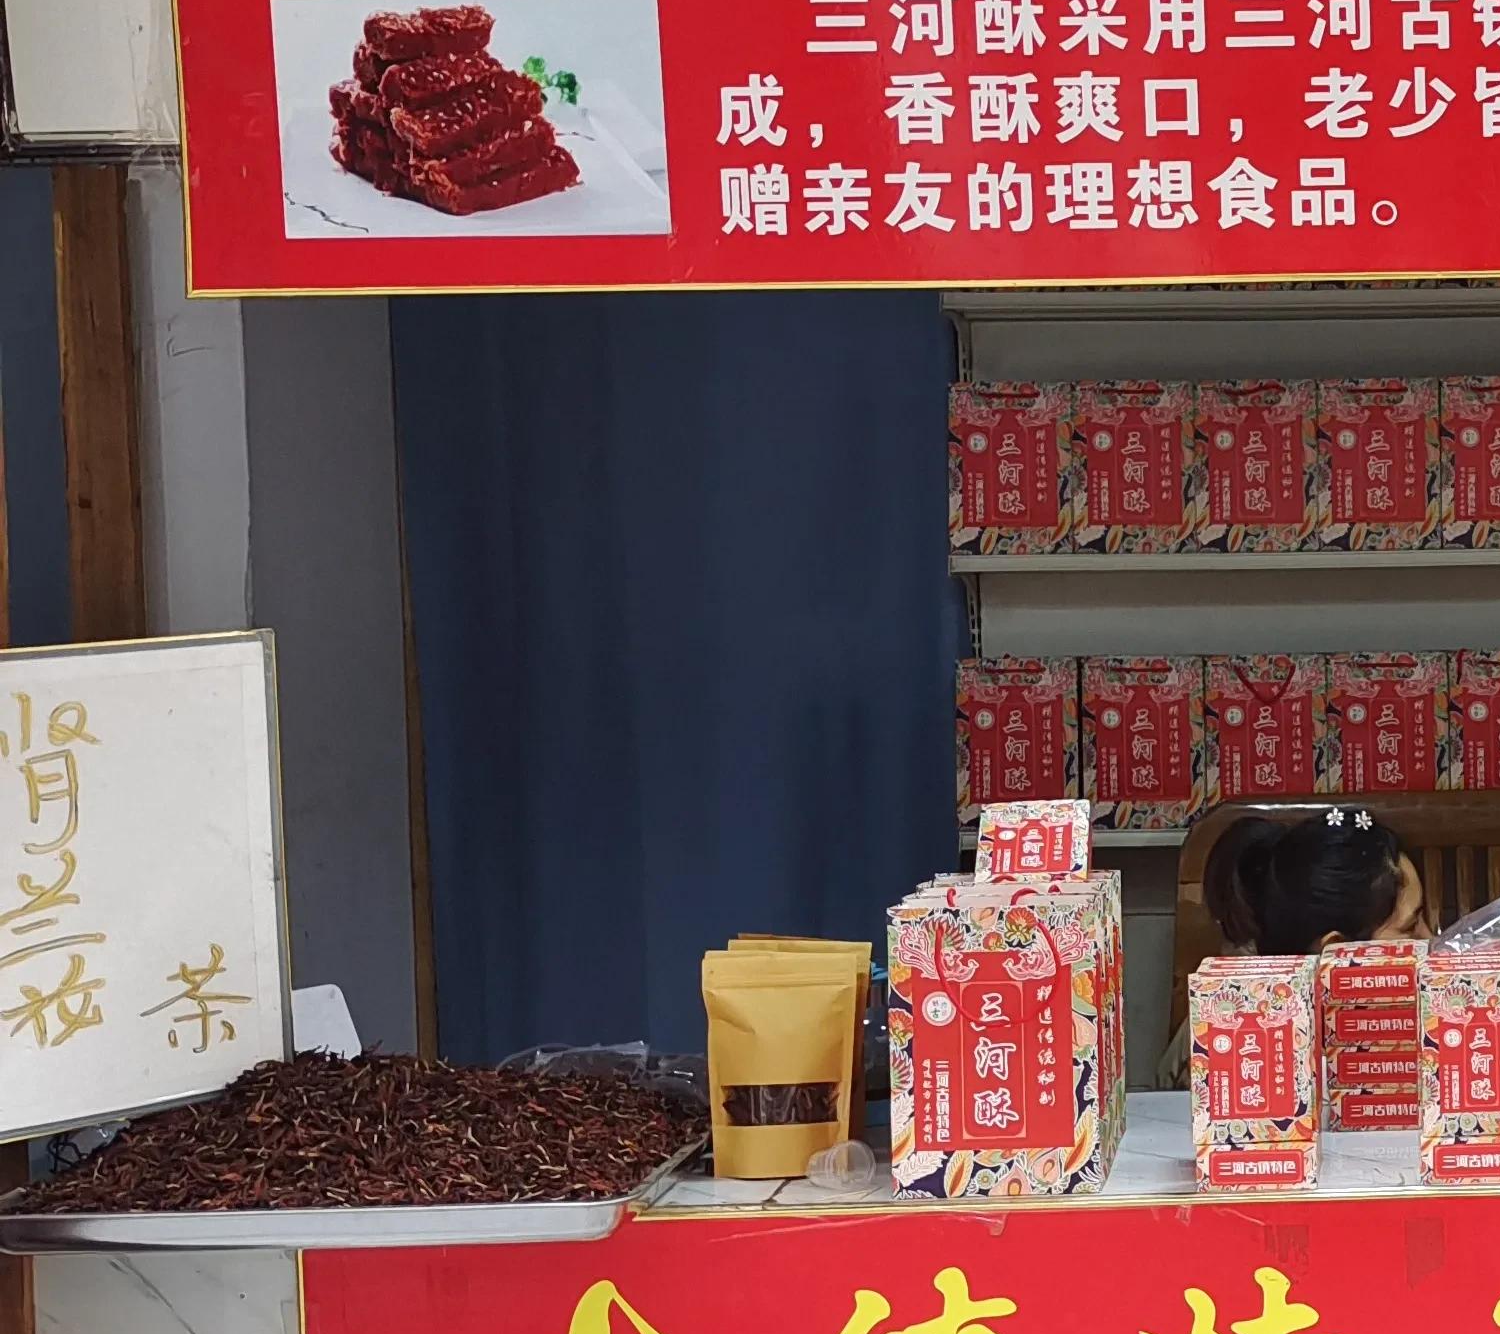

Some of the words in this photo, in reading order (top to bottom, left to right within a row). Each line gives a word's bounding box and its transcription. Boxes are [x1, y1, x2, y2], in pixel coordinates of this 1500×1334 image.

[720, 156, 1398, 236] 赠亲友的理想食品。
[970, 993, 1019, 1128] 三河酥
